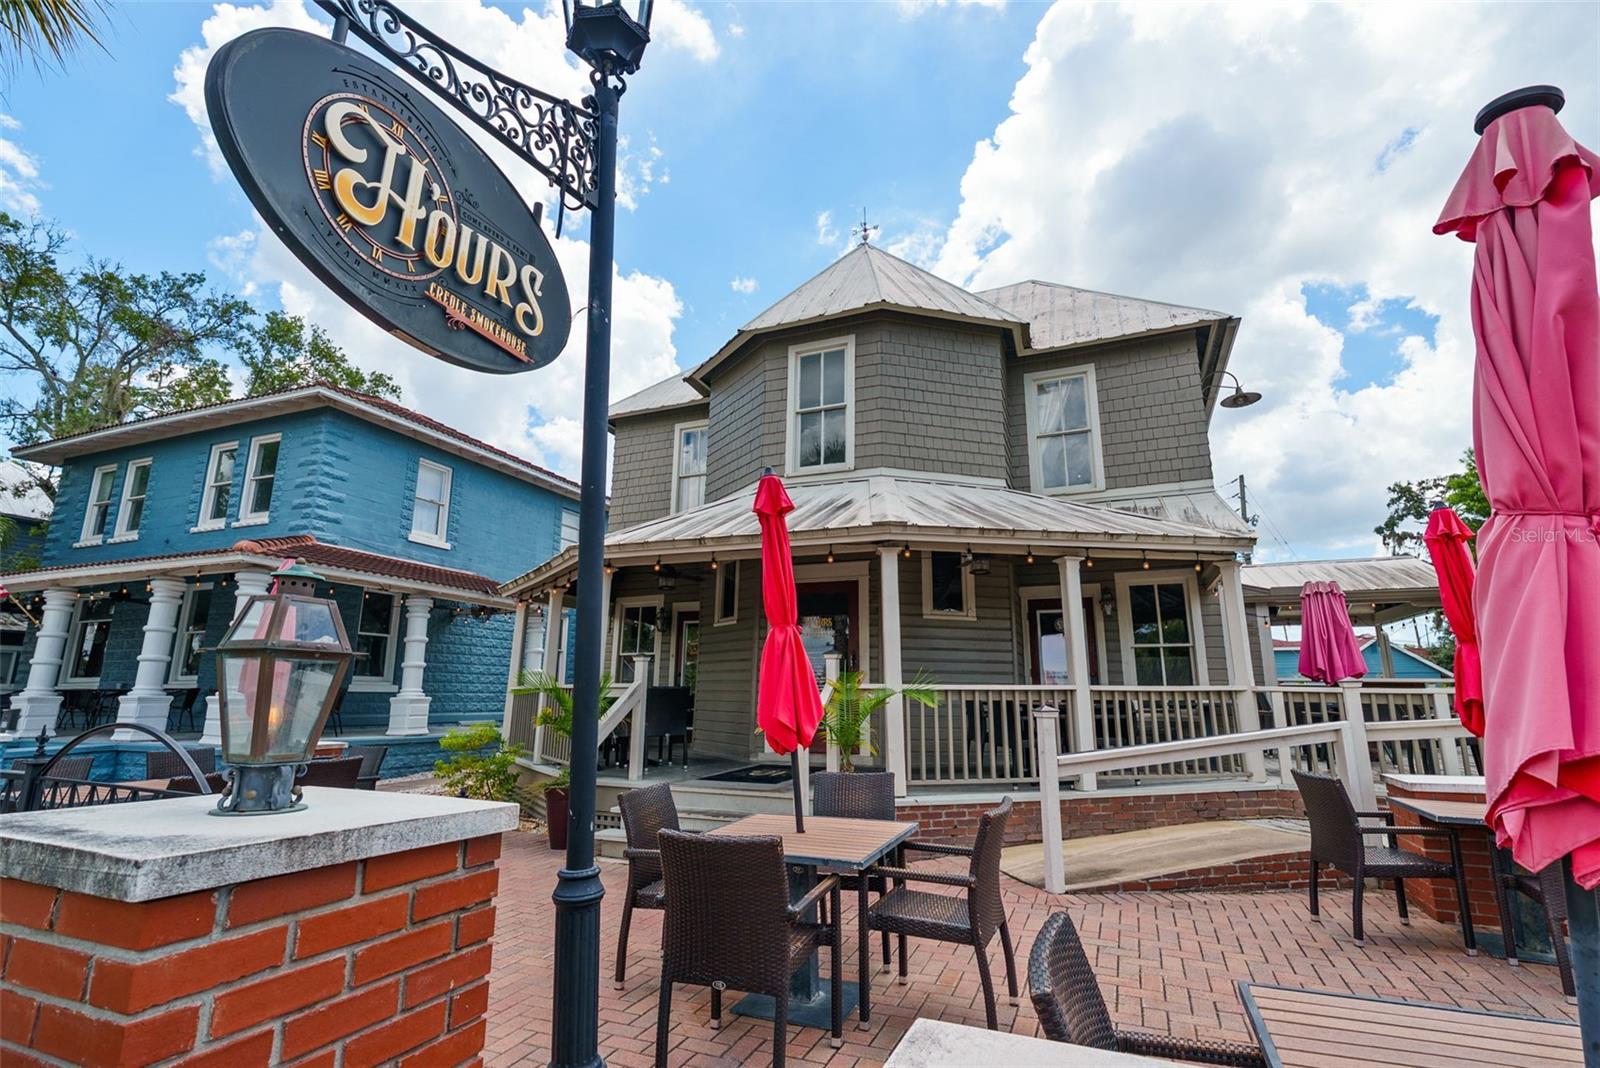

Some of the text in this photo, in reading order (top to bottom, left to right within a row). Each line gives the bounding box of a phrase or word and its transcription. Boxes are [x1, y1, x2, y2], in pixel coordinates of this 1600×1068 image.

[343, 79, 437, 153] ESTABLISHED
[391, 120, 405, 139] XII
[463, 211, 481, 227] COME
[326, 230, 361, 268] YEAR
[430, 282, 528, 356] CREOLE SMOKEHOUSE
